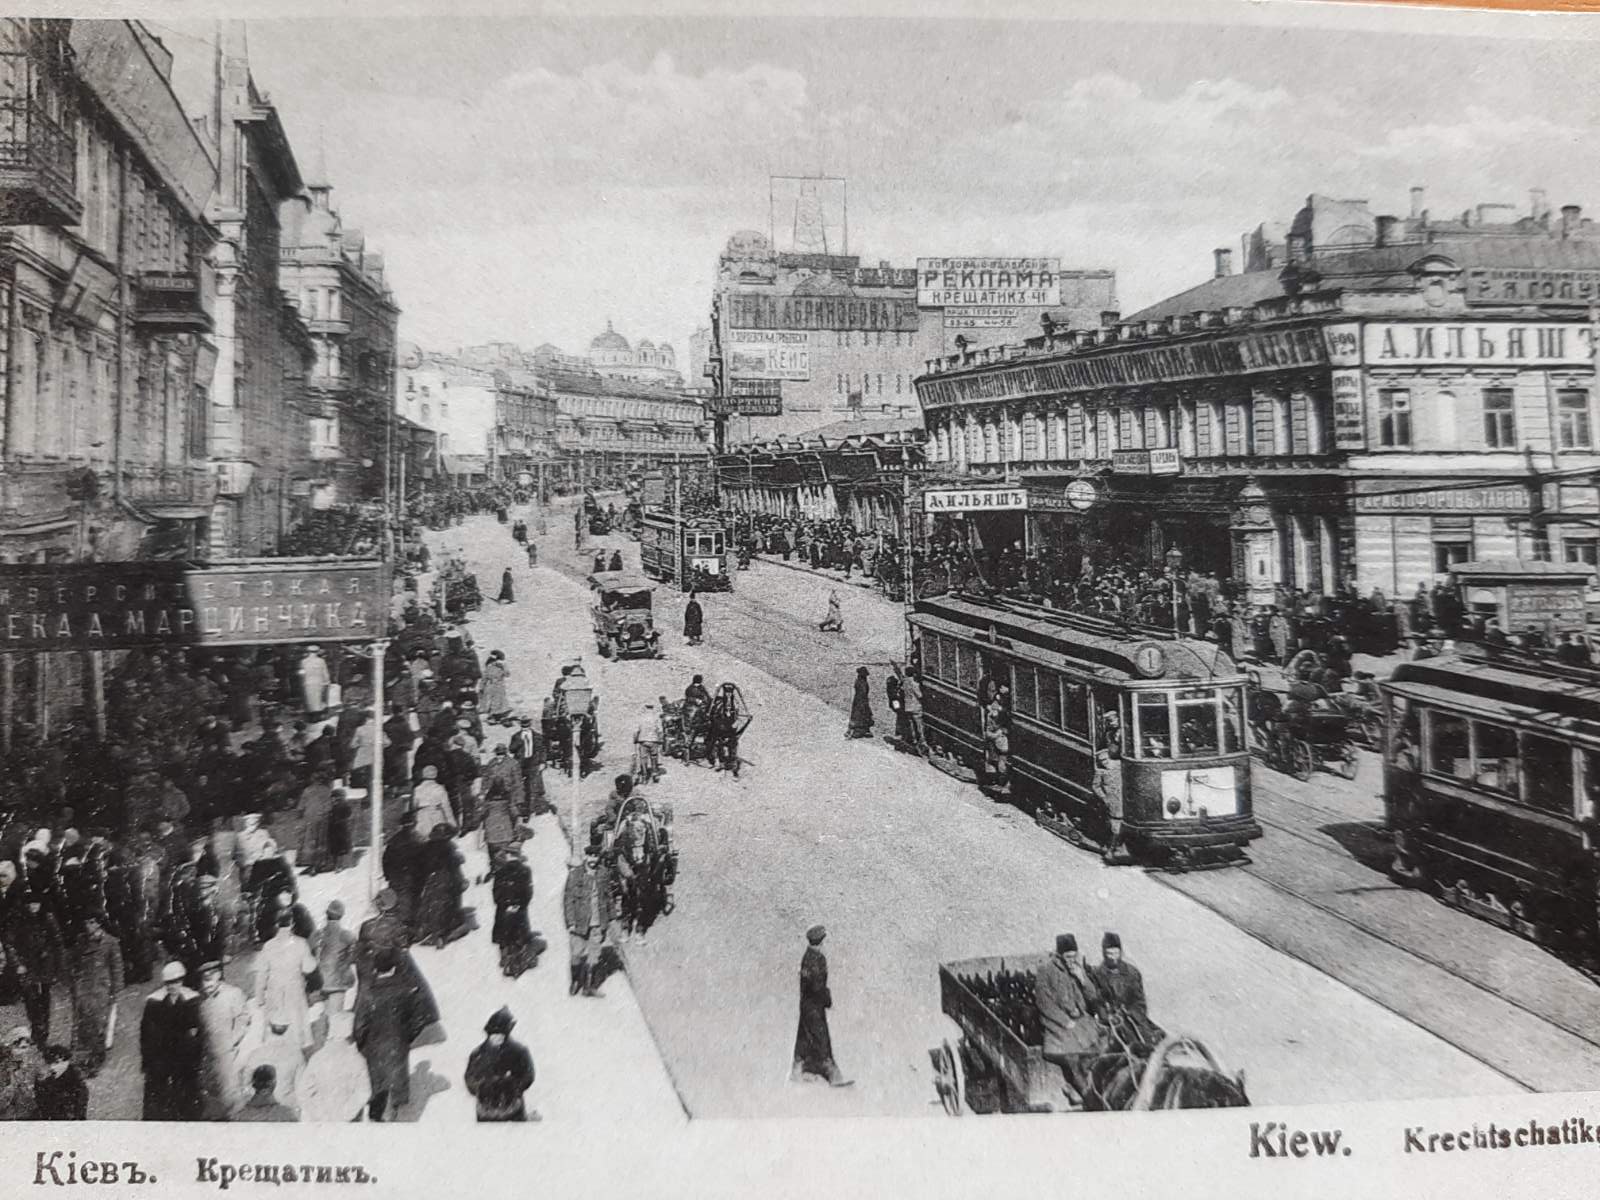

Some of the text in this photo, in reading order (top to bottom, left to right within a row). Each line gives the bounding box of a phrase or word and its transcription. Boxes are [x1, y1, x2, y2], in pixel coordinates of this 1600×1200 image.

[924, 269, 1054, 288] РЕКЛАМА
[1248, 1121, 1352, 1158] Kiew.
[33, 1151, 379, 1190] Кіевъ. Крещатикъ.
